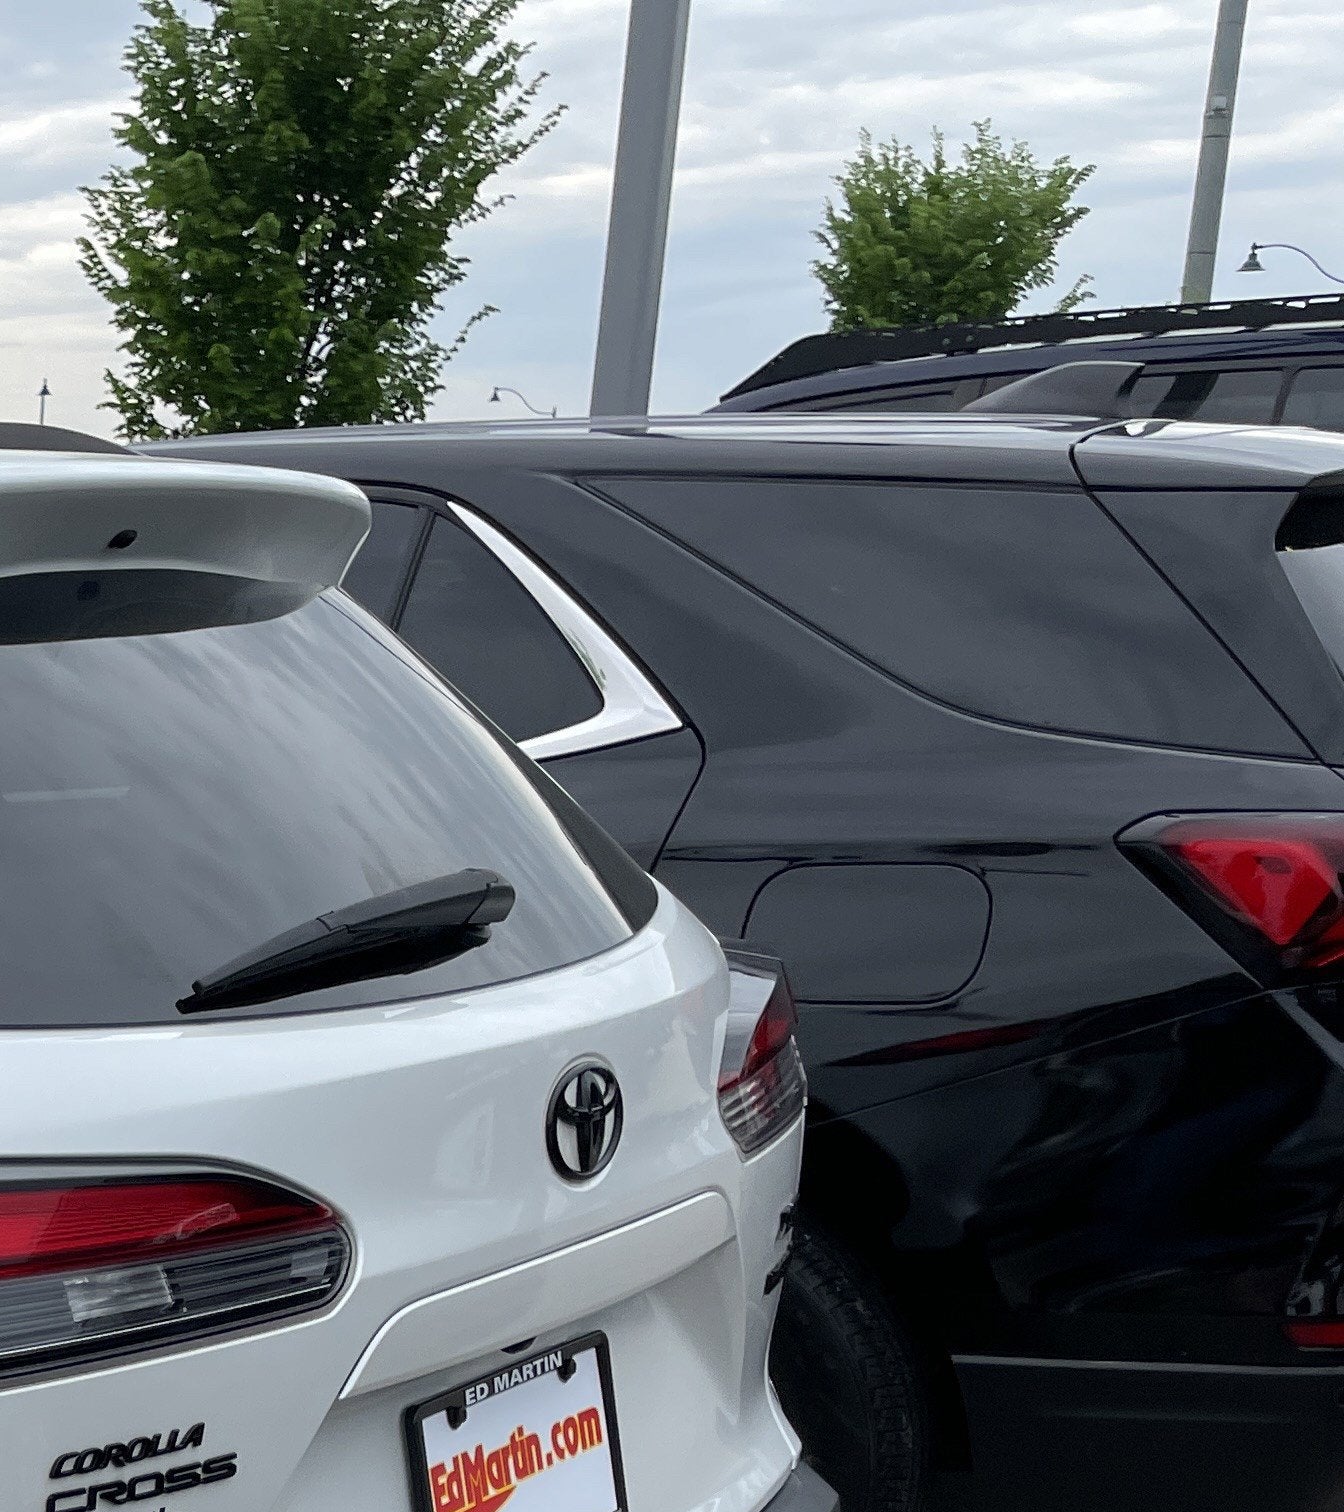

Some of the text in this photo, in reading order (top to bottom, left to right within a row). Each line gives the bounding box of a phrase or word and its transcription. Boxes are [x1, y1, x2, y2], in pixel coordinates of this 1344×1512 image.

[465, 1350, 563, 1406] ED MARTIN
[48, 1421, 206, 1479] COROLLA
